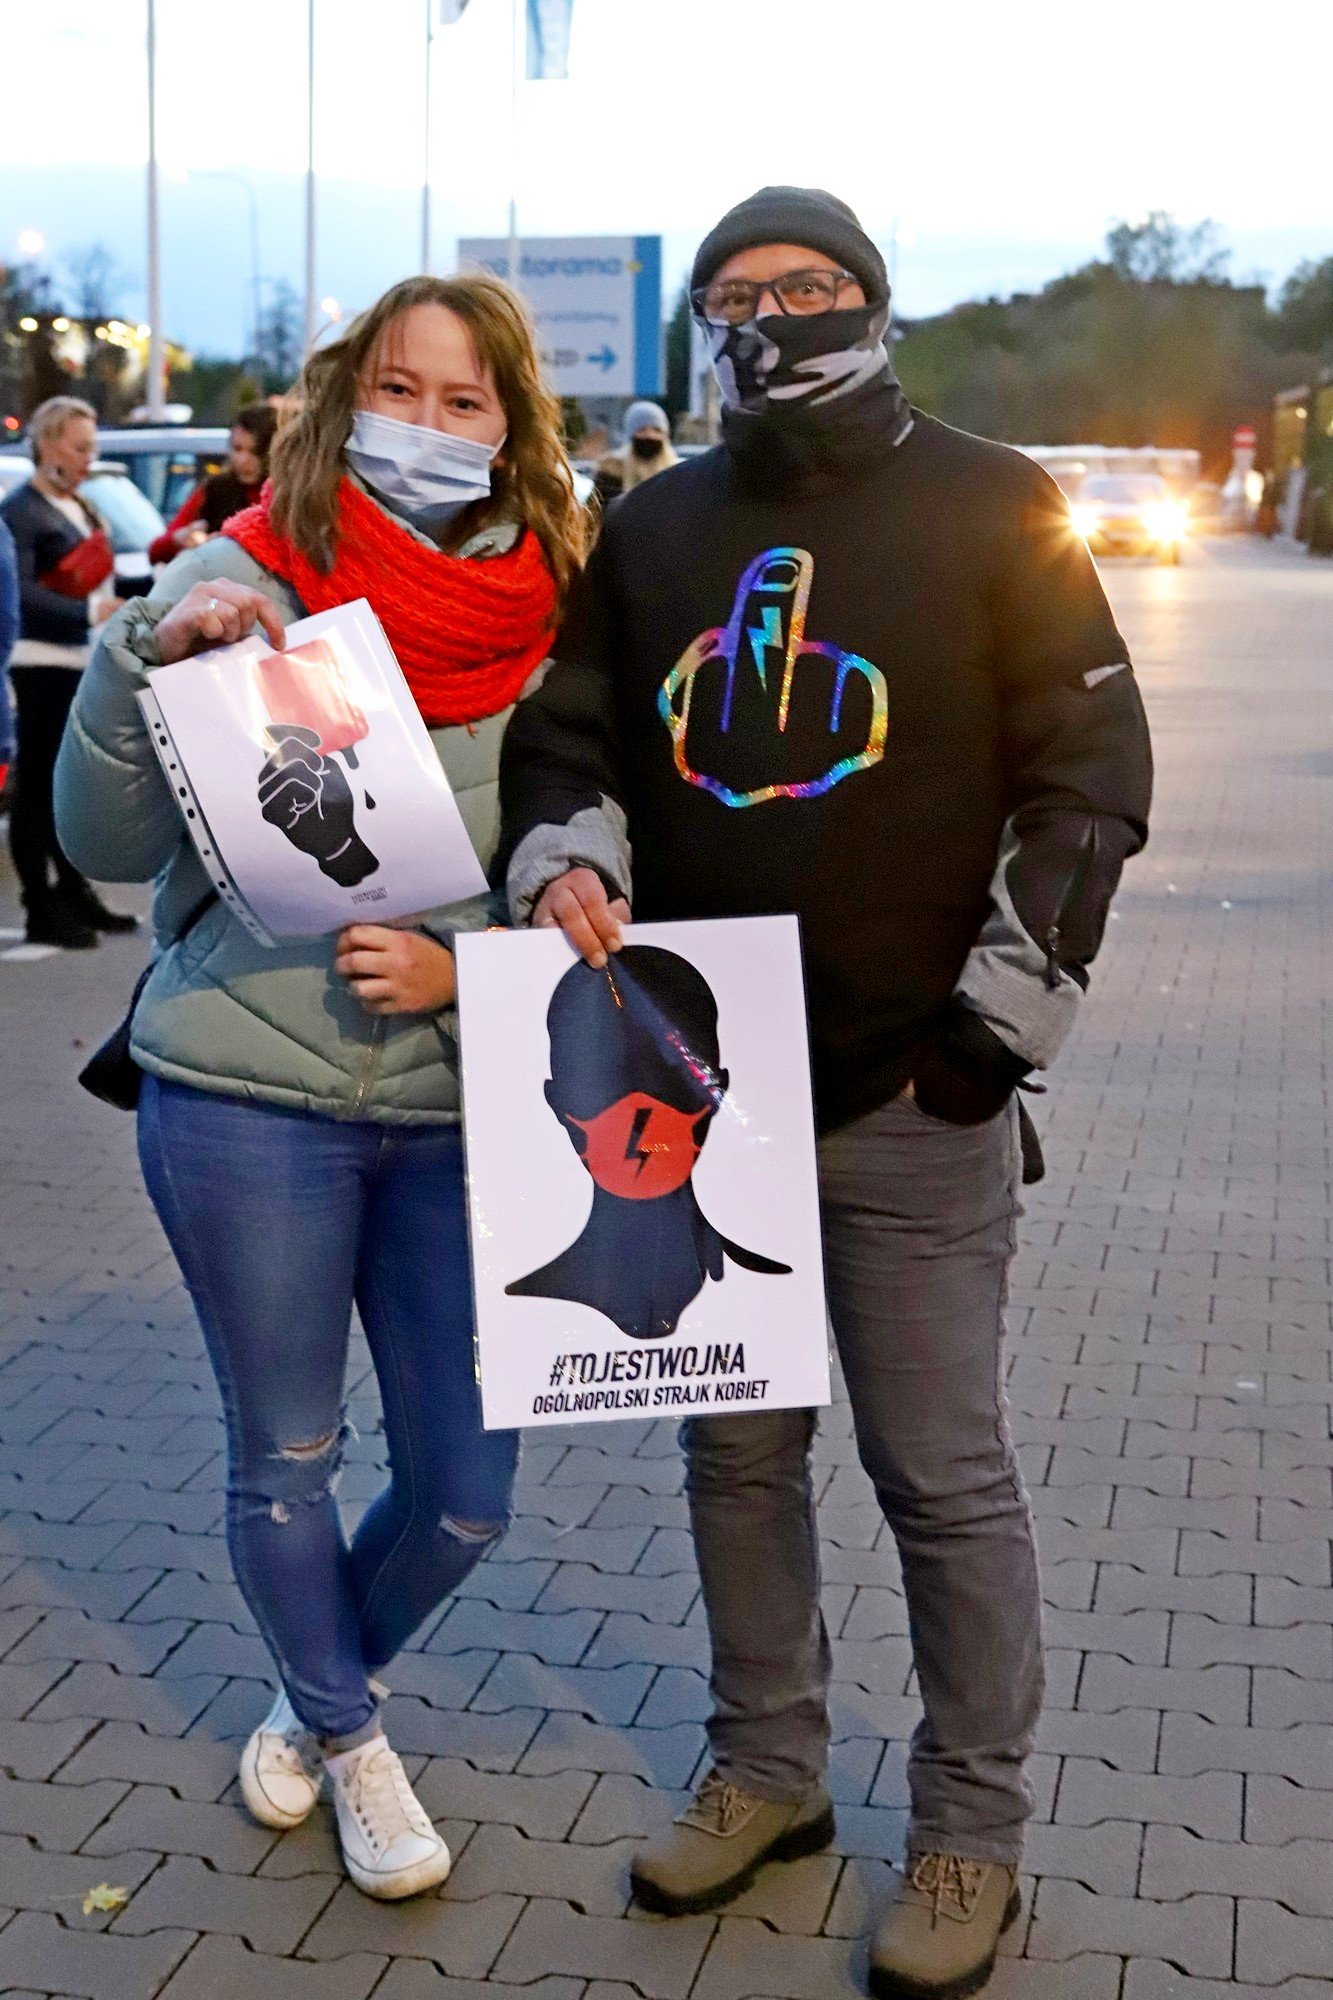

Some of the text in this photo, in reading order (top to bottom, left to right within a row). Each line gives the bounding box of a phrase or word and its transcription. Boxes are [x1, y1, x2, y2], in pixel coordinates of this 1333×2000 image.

[550, 1343, 745, 1386] #TOJESTWOJNA
[533, 1380, 769, 1414] OGÓLNOPOLSKI STRAJK KOBIET
